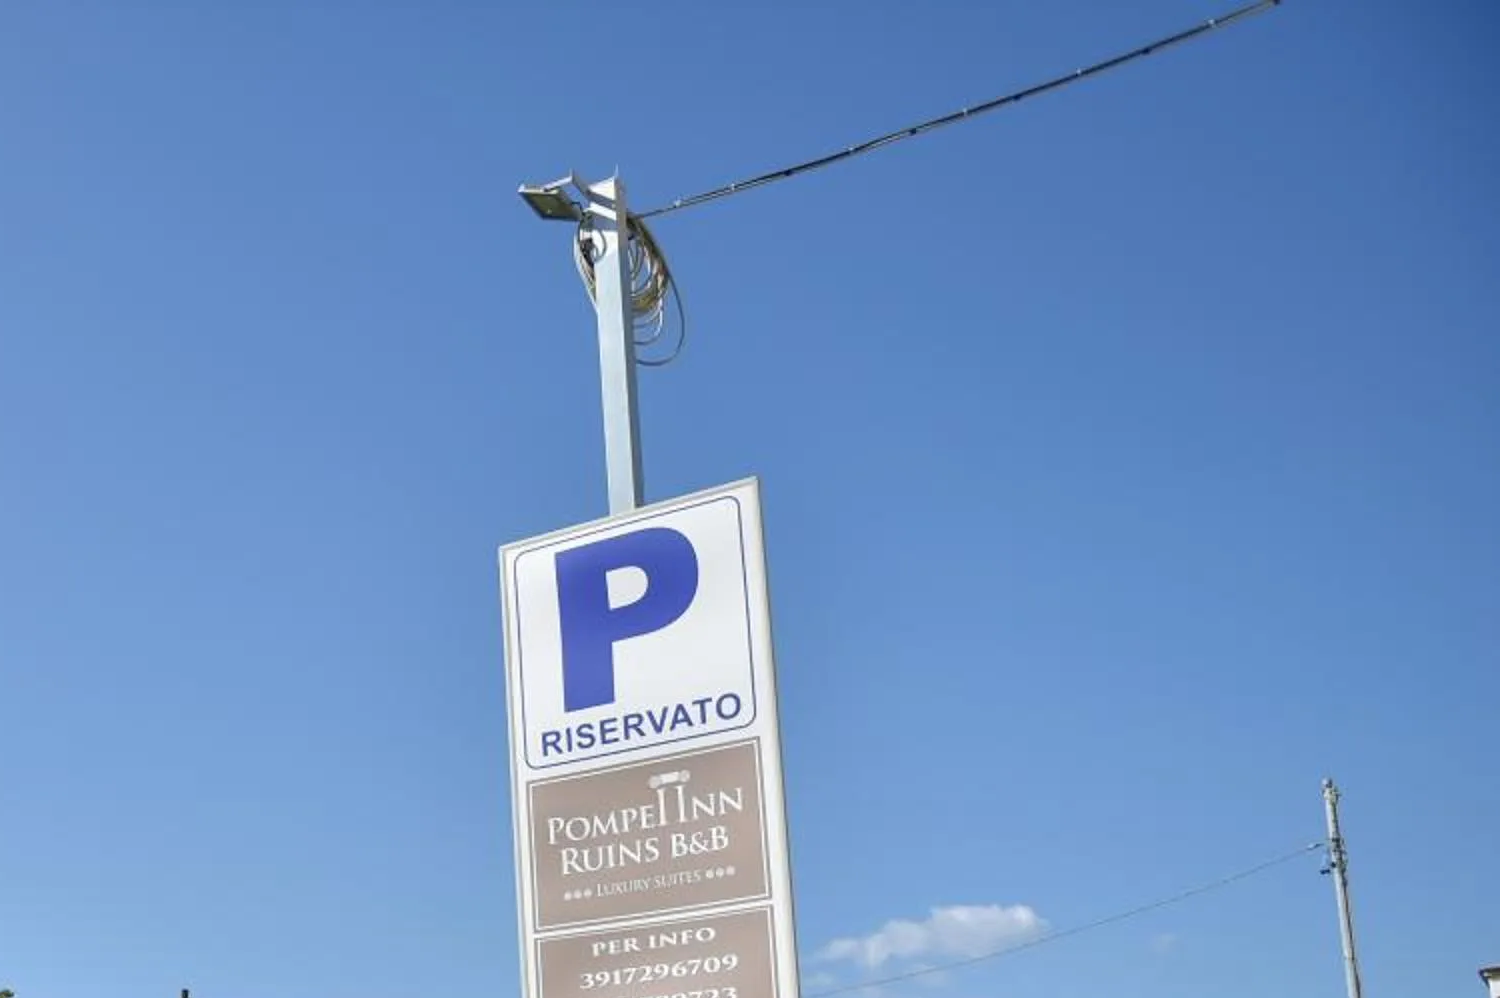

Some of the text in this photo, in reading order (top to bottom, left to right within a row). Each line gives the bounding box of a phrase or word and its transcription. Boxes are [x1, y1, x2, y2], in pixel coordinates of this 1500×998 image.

[555, 527, 699, 713] P
[541, 693, 741, 757] RISERVATO
[561, 825, 729, 875] RUINS B&B
[596, 868, 702, 897] LUXURY SUITES
[592, 927, 716, 957] PER INFO
[579, 953, 739, 989] 3917296709
